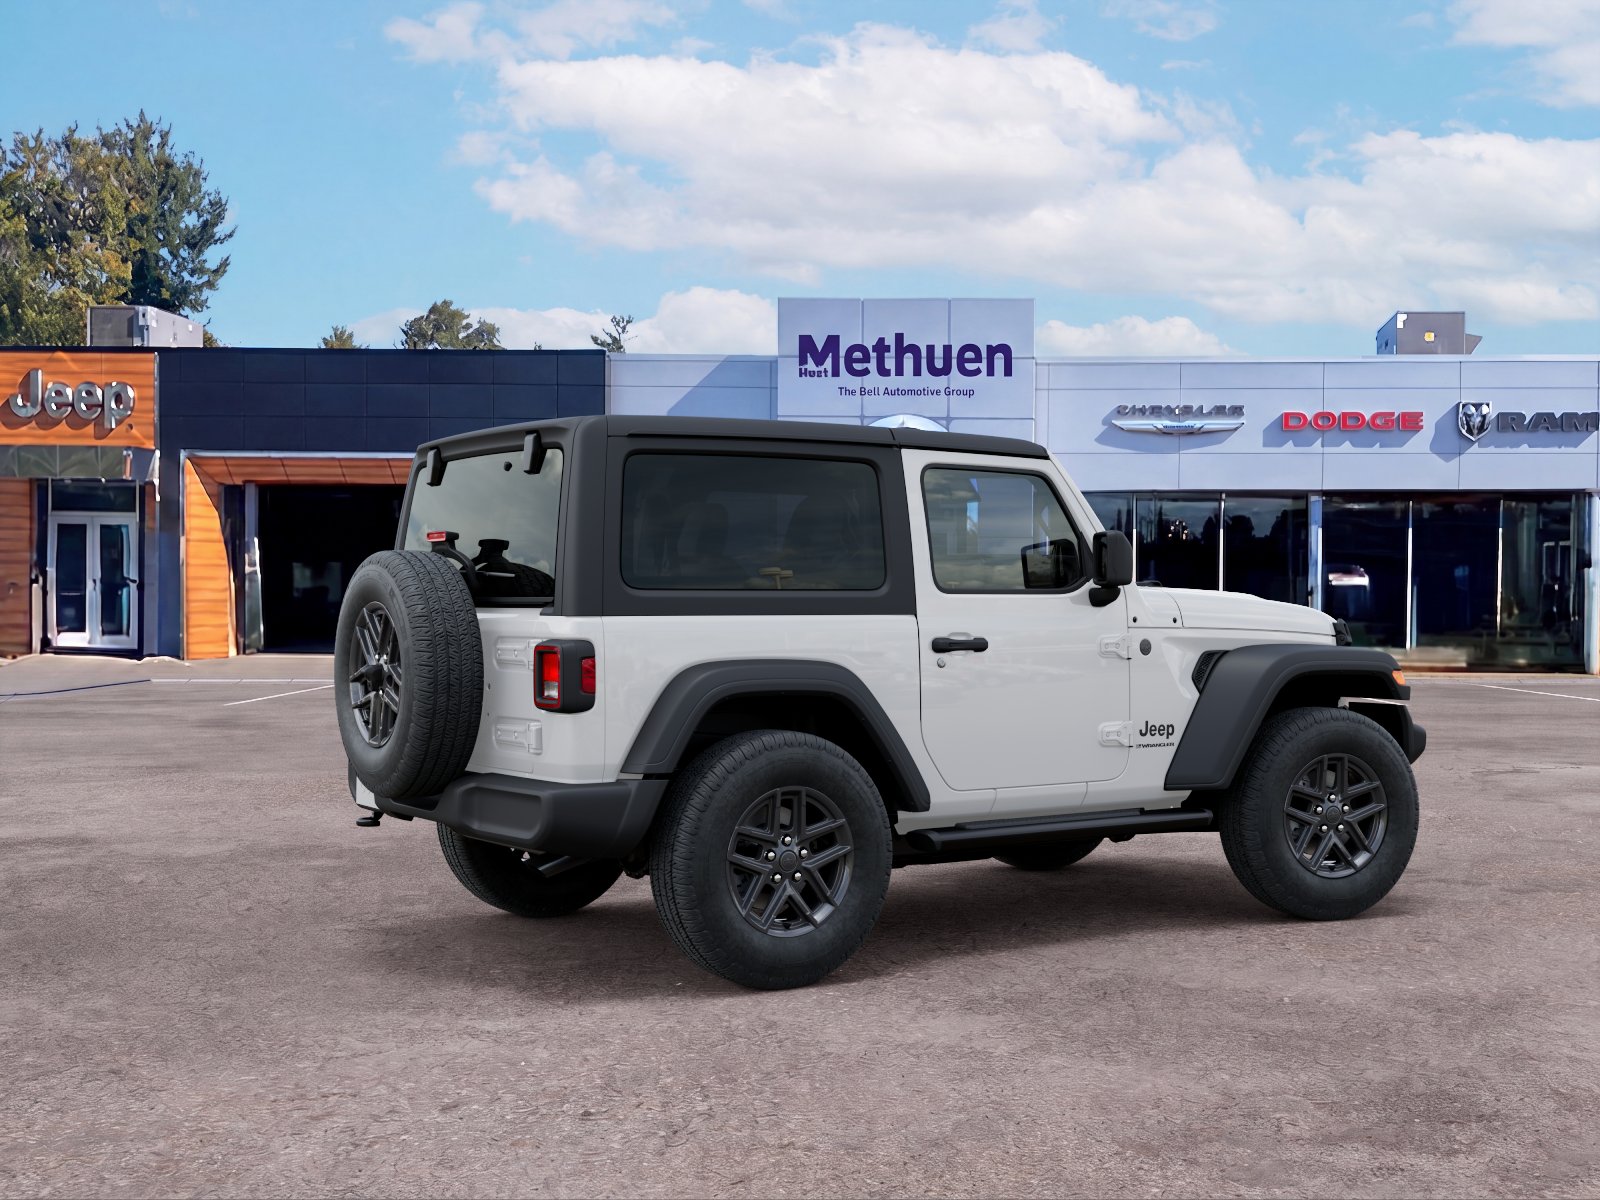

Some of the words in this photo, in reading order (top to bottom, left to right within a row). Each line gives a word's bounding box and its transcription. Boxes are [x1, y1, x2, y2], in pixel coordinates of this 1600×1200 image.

[798, 332, 1013, 378] Methuen
[9, 368, 135, 429] Jeep
[838, 386, 857, 397] The
[859, 386, 880, 397] Bell
[883, 386, 942, 397] Automotive
[944, 386, 975, 399] Group
[1281, 411, 1424, 431] DODGE
[1497, 411, 1599, 432] RAM
[1139, 720, 1175, 739] Jeep
